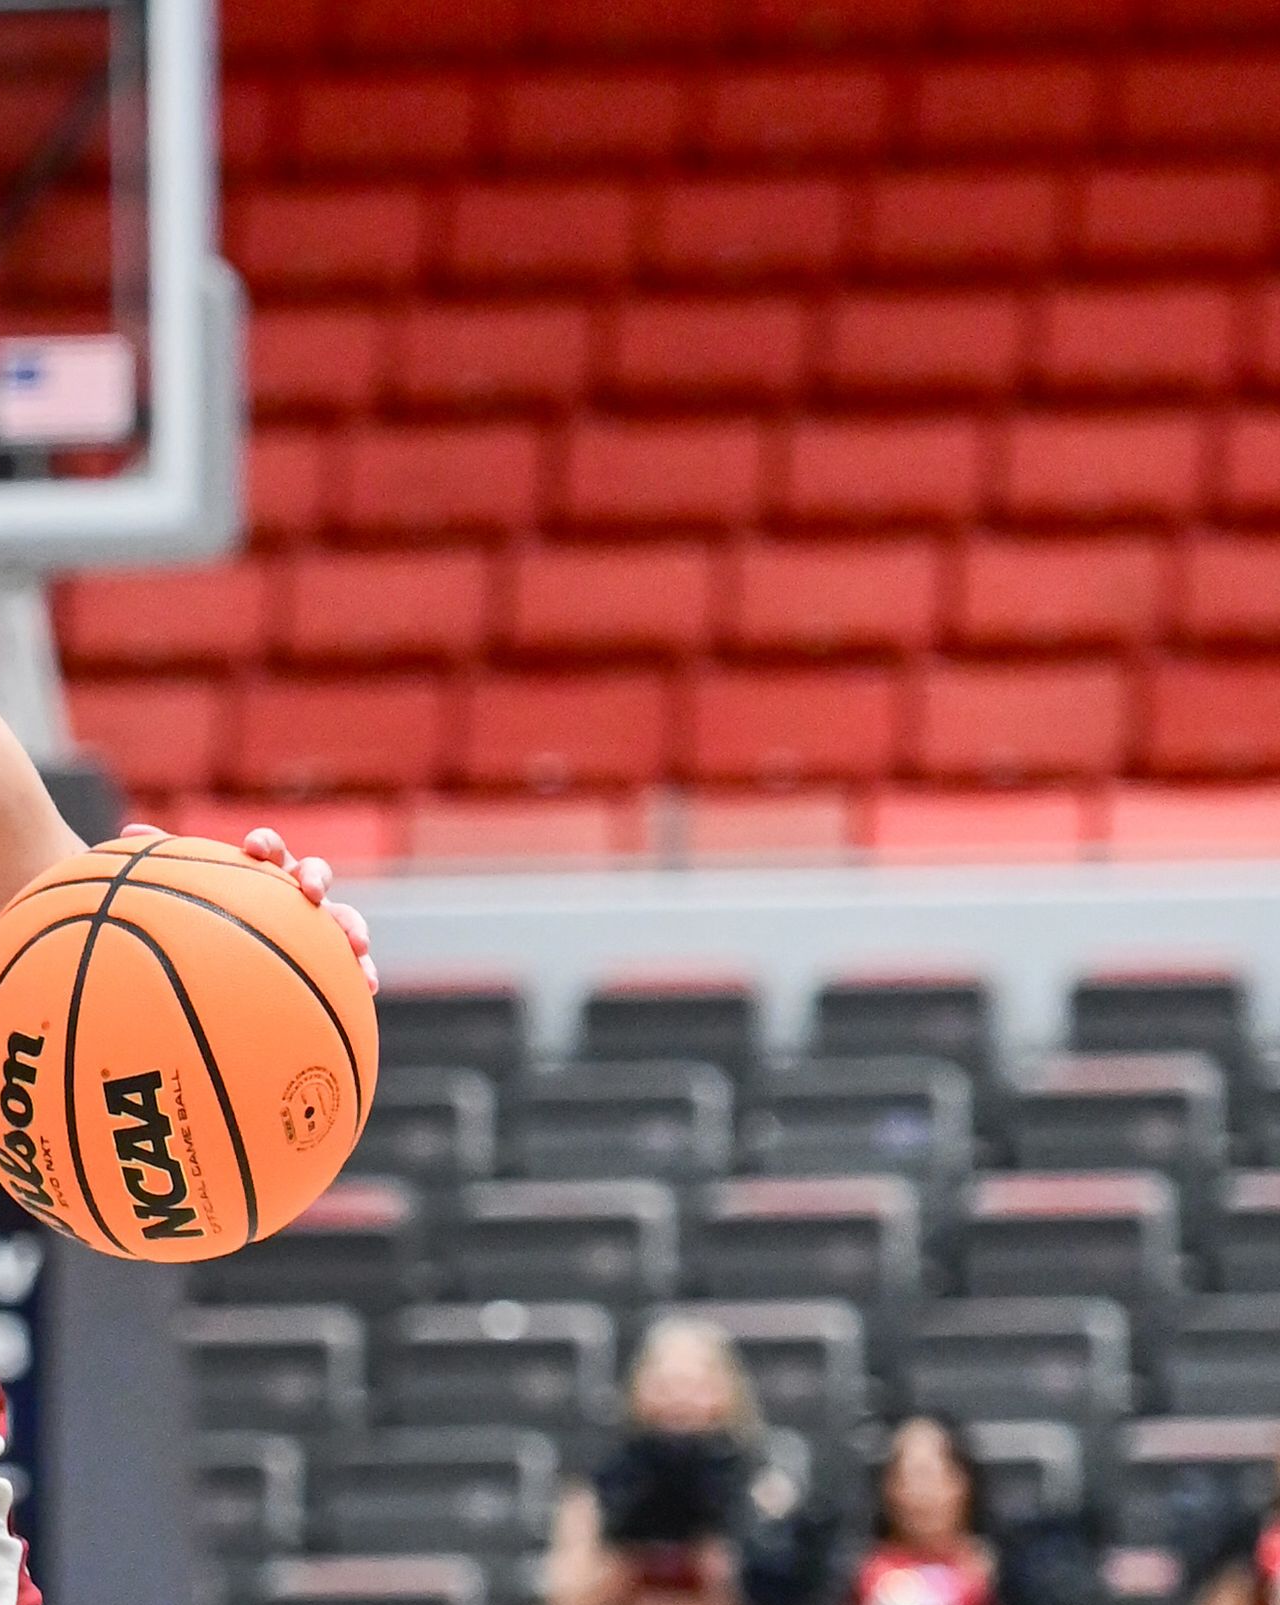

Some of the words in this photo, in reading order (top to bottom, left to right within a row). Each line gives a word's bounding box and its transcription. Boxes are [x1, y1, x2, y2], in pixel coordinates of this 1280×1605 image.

[170, 1068, 190, 1122] BALL
[40, 1135, 56, 1172] NXT
[102, 1070, 205, 1240] NCAA
